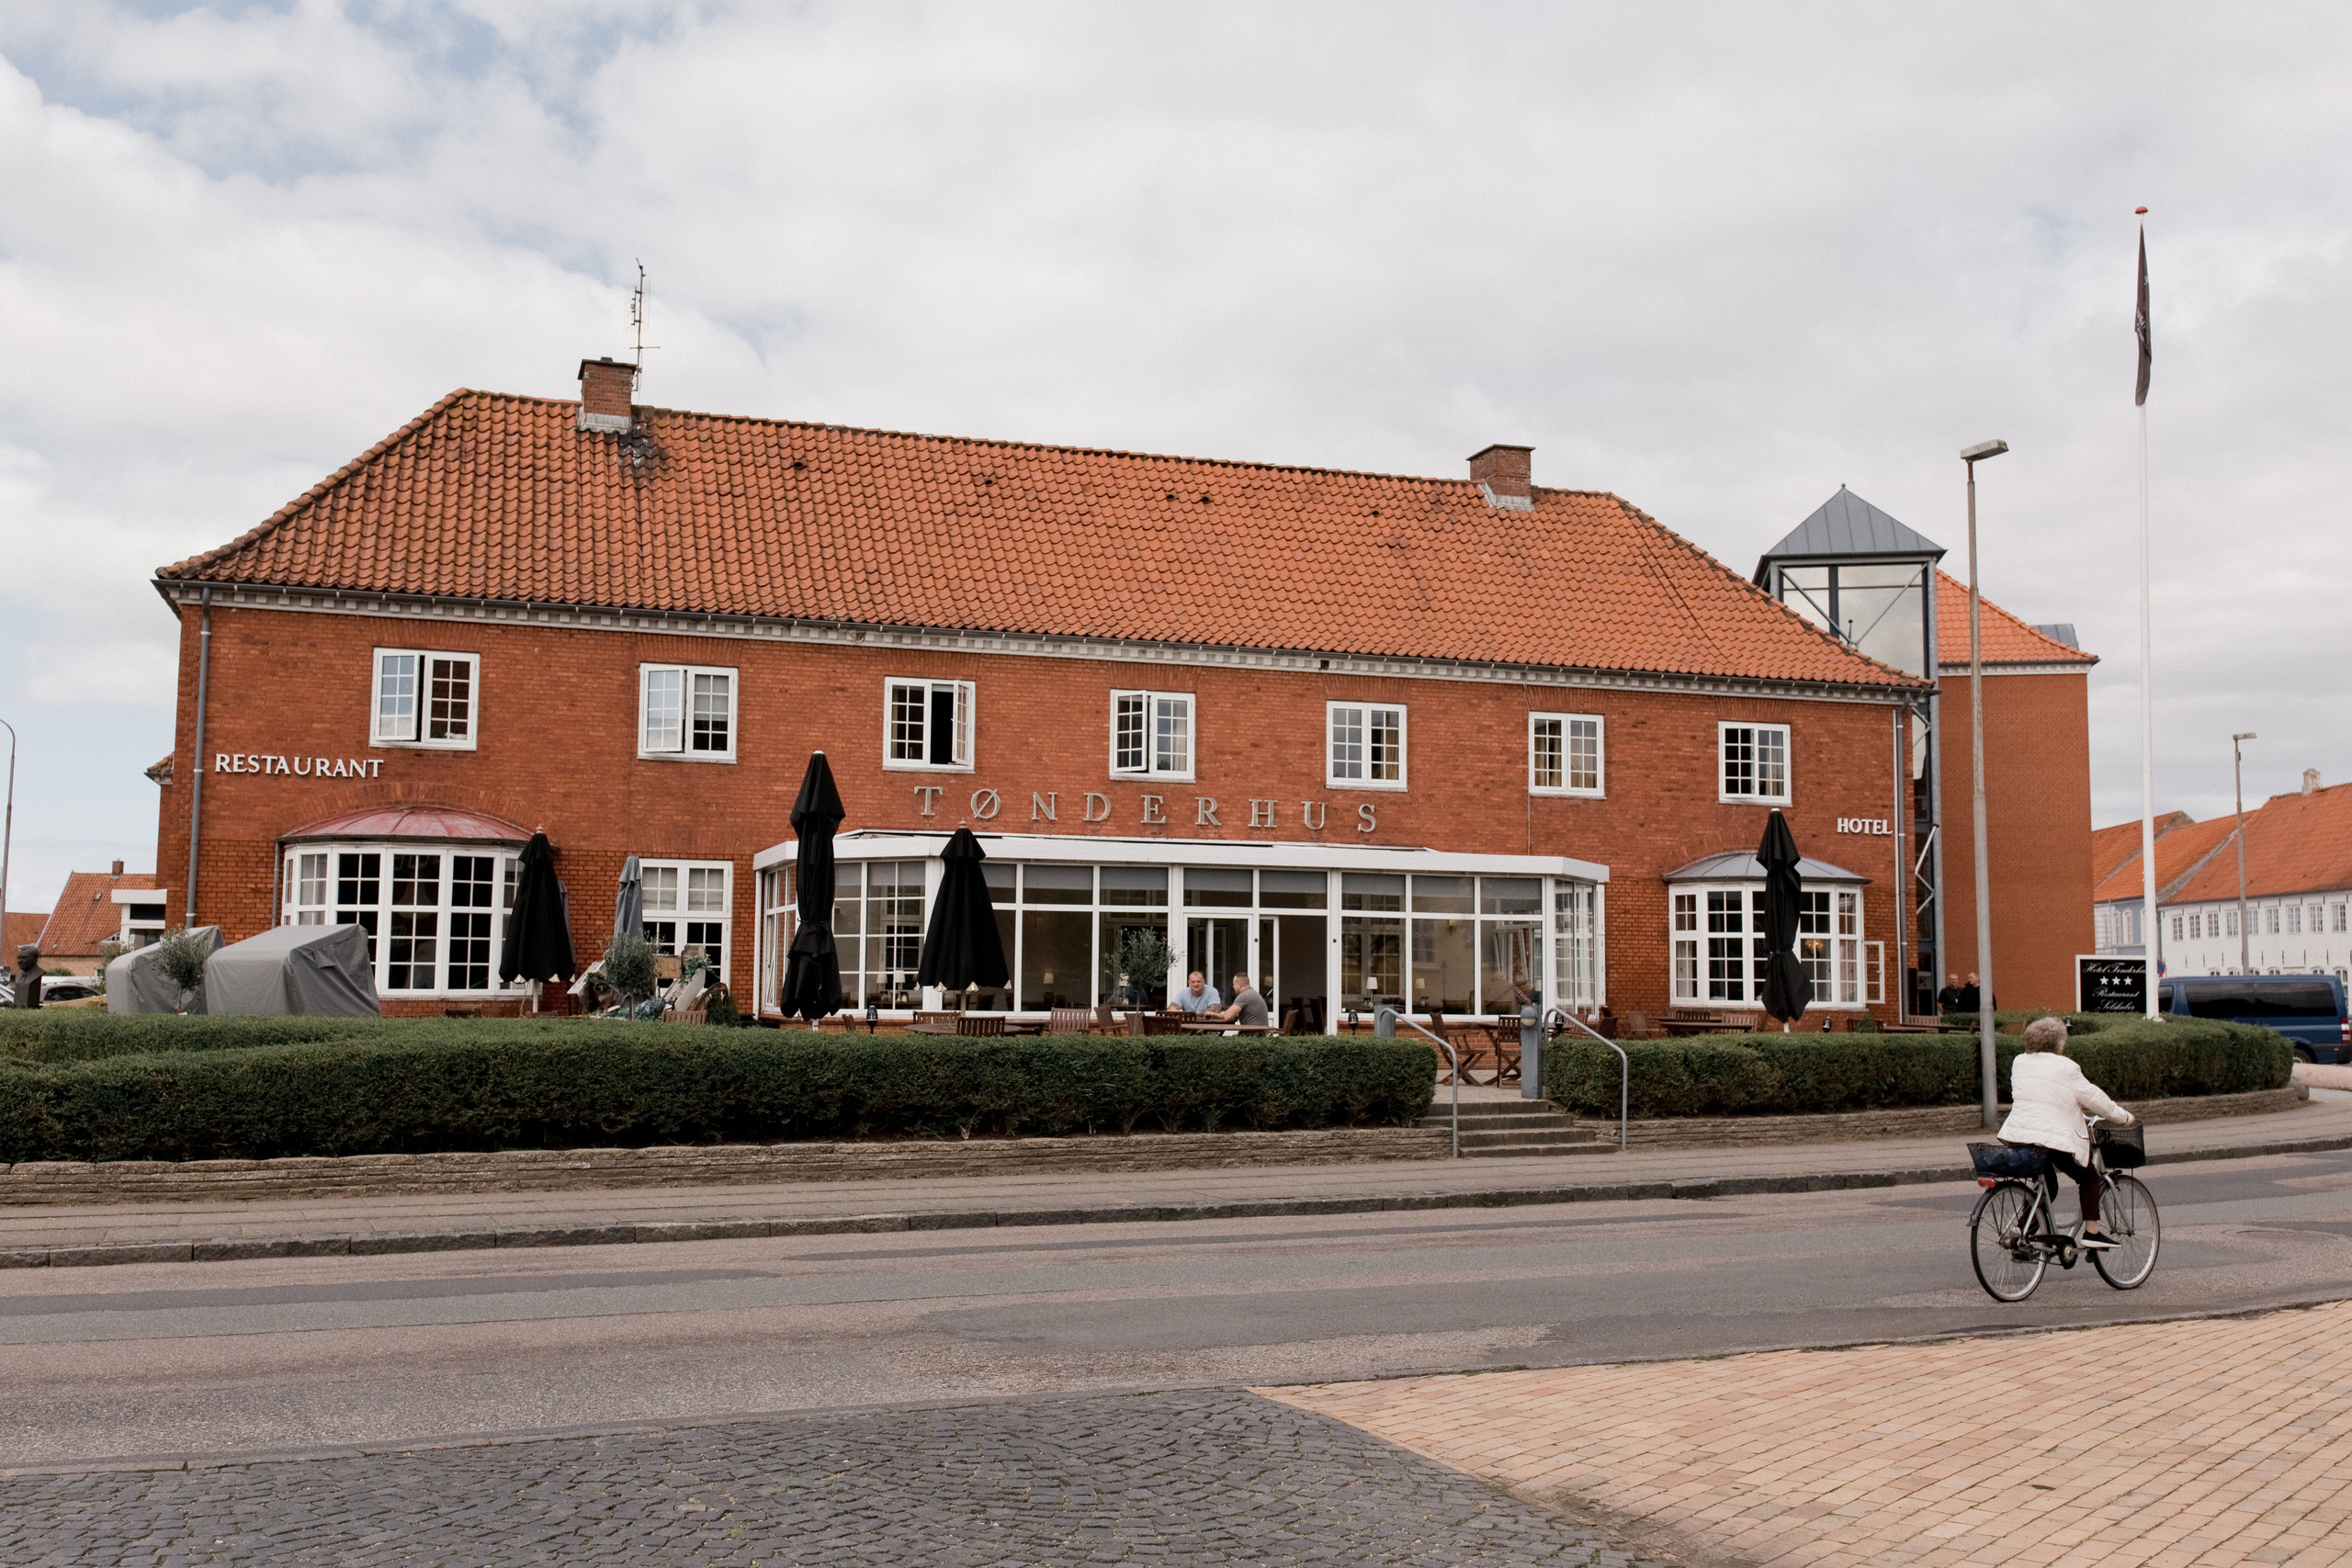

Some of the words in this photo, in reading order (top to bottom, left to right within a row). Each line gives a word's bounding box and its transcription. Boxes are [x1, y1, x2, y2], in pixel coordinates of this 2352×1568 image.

[215, 753, 384, 778] RESTAURANT
[914, 785, 1377, 833] TØNDERHUS
[1837, 818, 1893, 834] HOTEL
[2082, 962, 2109, 974] Hotel
[2092, 986, 2140, 998] Restaurant
